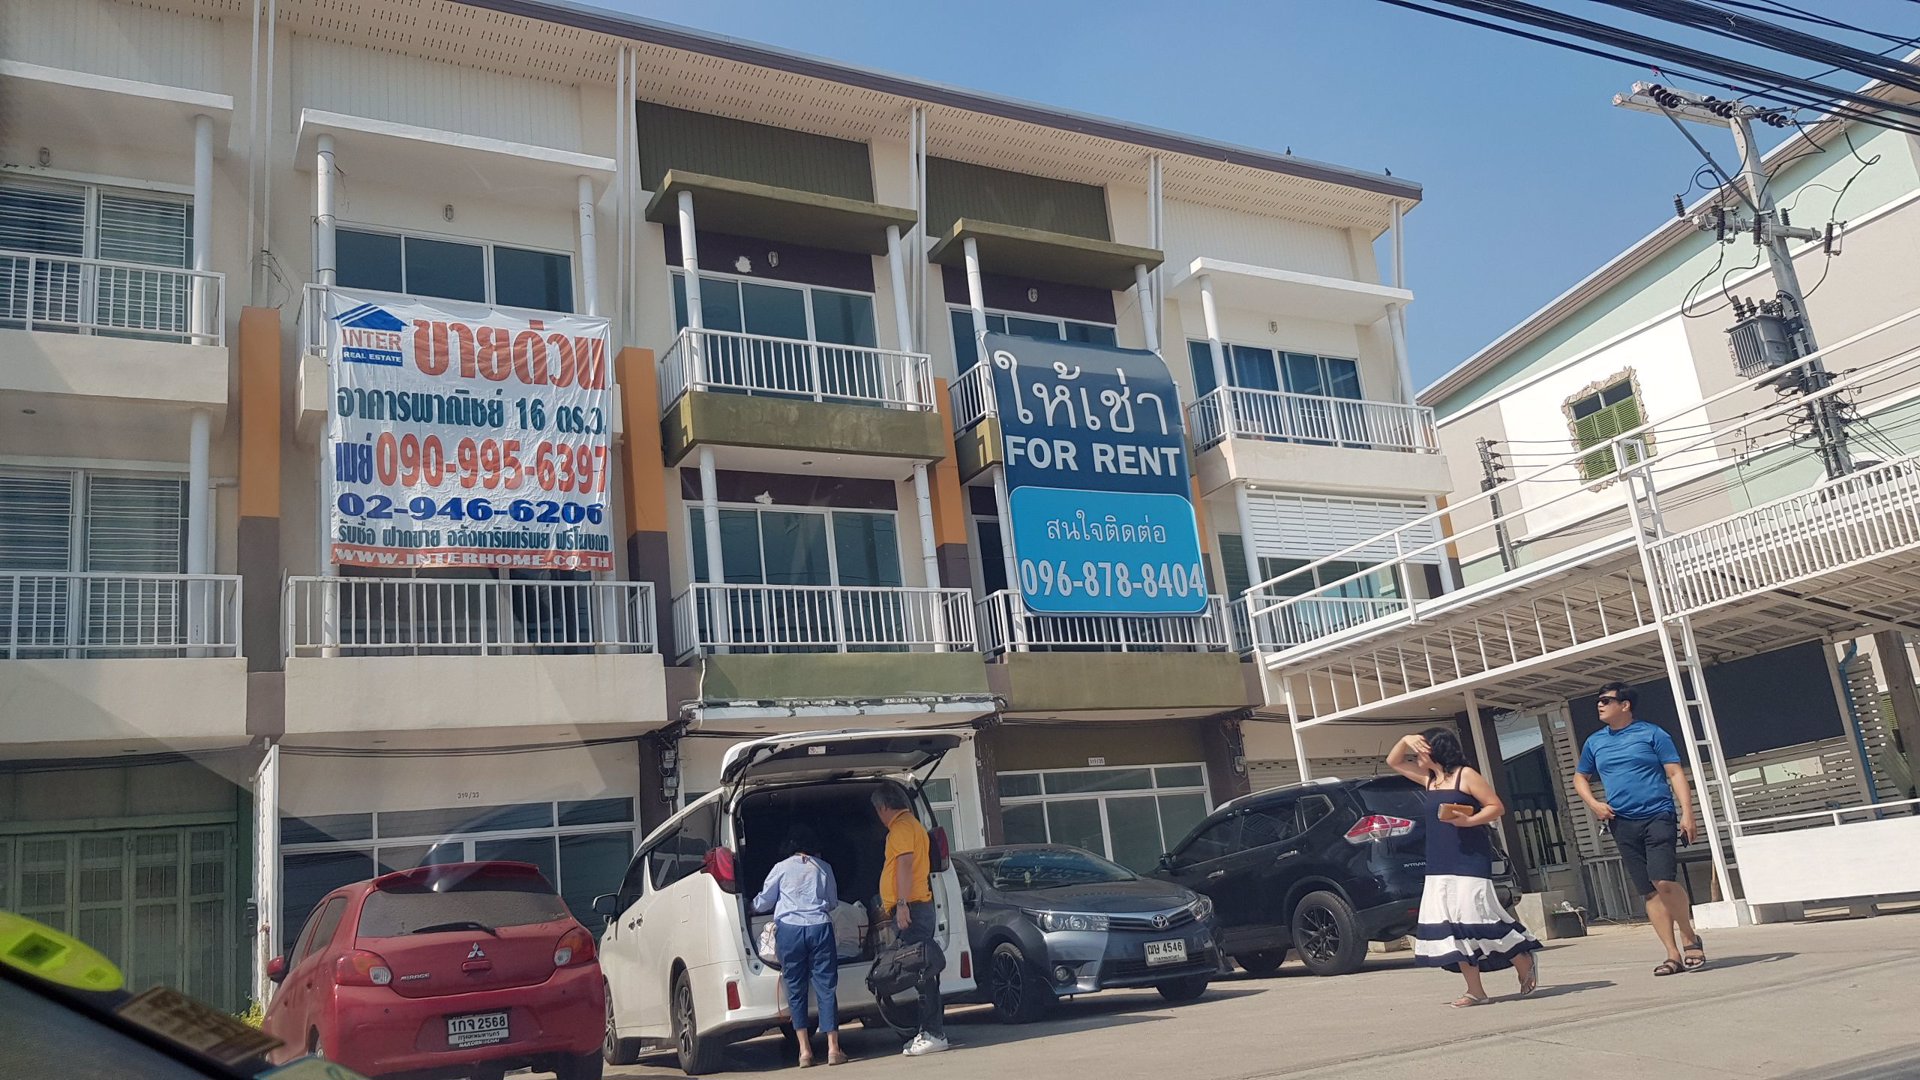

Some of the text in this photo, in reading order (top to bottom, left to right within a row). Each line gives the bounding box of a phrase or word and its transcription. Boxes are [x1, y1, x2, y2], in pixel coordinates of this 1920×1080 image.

[342, 329, 402, 351] INTER
[343, 351, 402, 363] REAL ESTATE
[413, 319, 605, 390] ขายด่วน
[337, 387, 504, 428] อาคารพาณิชย์
[515, 398, 546, 431] 16
[994, 350, 1168, 435] ให้เช่า
[376, 432, 607, 494] 090-995-6397
[1006, 435, 1180, 476] FOR RENT
[337, 493, 603, 525] 02-946-6206
[1047, 509, 1166, 543] สนใจติดต่อ
[338, 516, 377, 545] รับซื้อ
[382, 526, 441, 548] ฝากขาย
[1021, 559, 1204, 598] 096-878-8404
[1163, 941, 1183, 953] 4546
[478, 1016, 506, 1029] 2568
